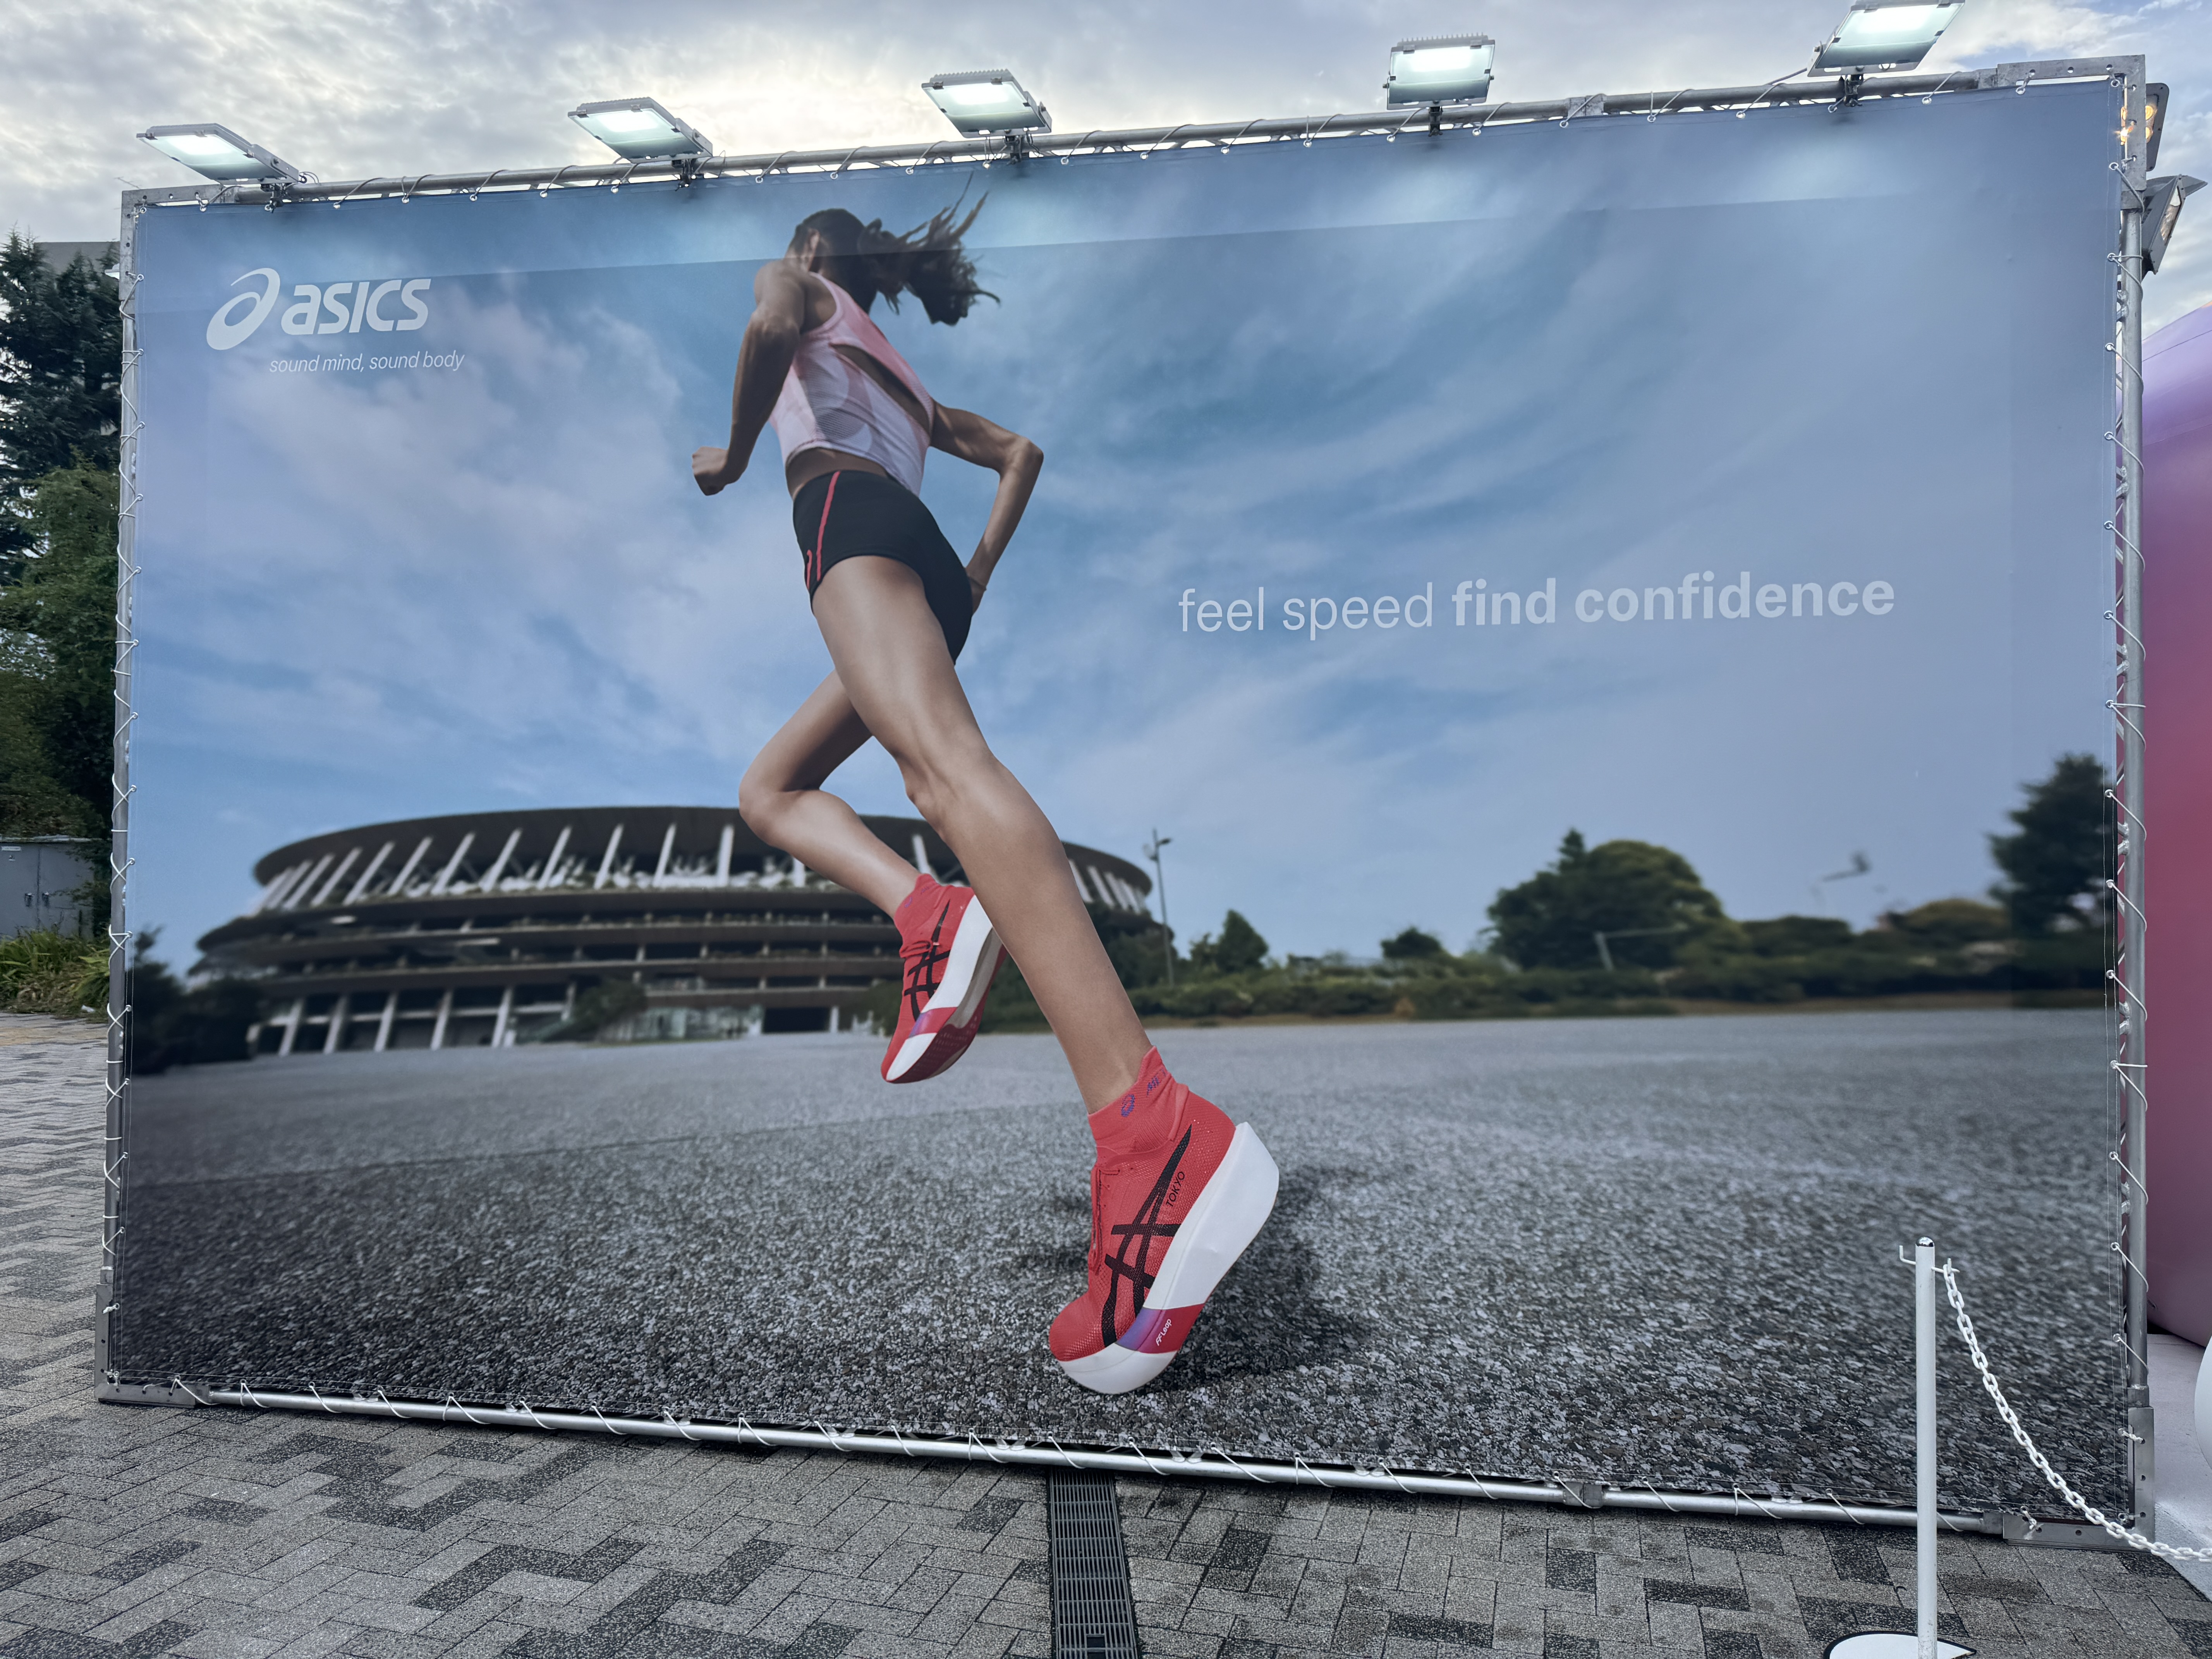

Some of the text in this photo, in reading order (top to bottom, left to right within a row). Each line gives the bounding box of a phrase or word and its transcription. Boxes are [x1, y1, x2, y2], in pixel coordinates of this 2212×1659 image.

[270, 350, 465, 373] sound mind, sound body
[1178, 570, 1894, 641] feel speed find confidence
[1165, 1171, 1185, 1207] TOKYO
